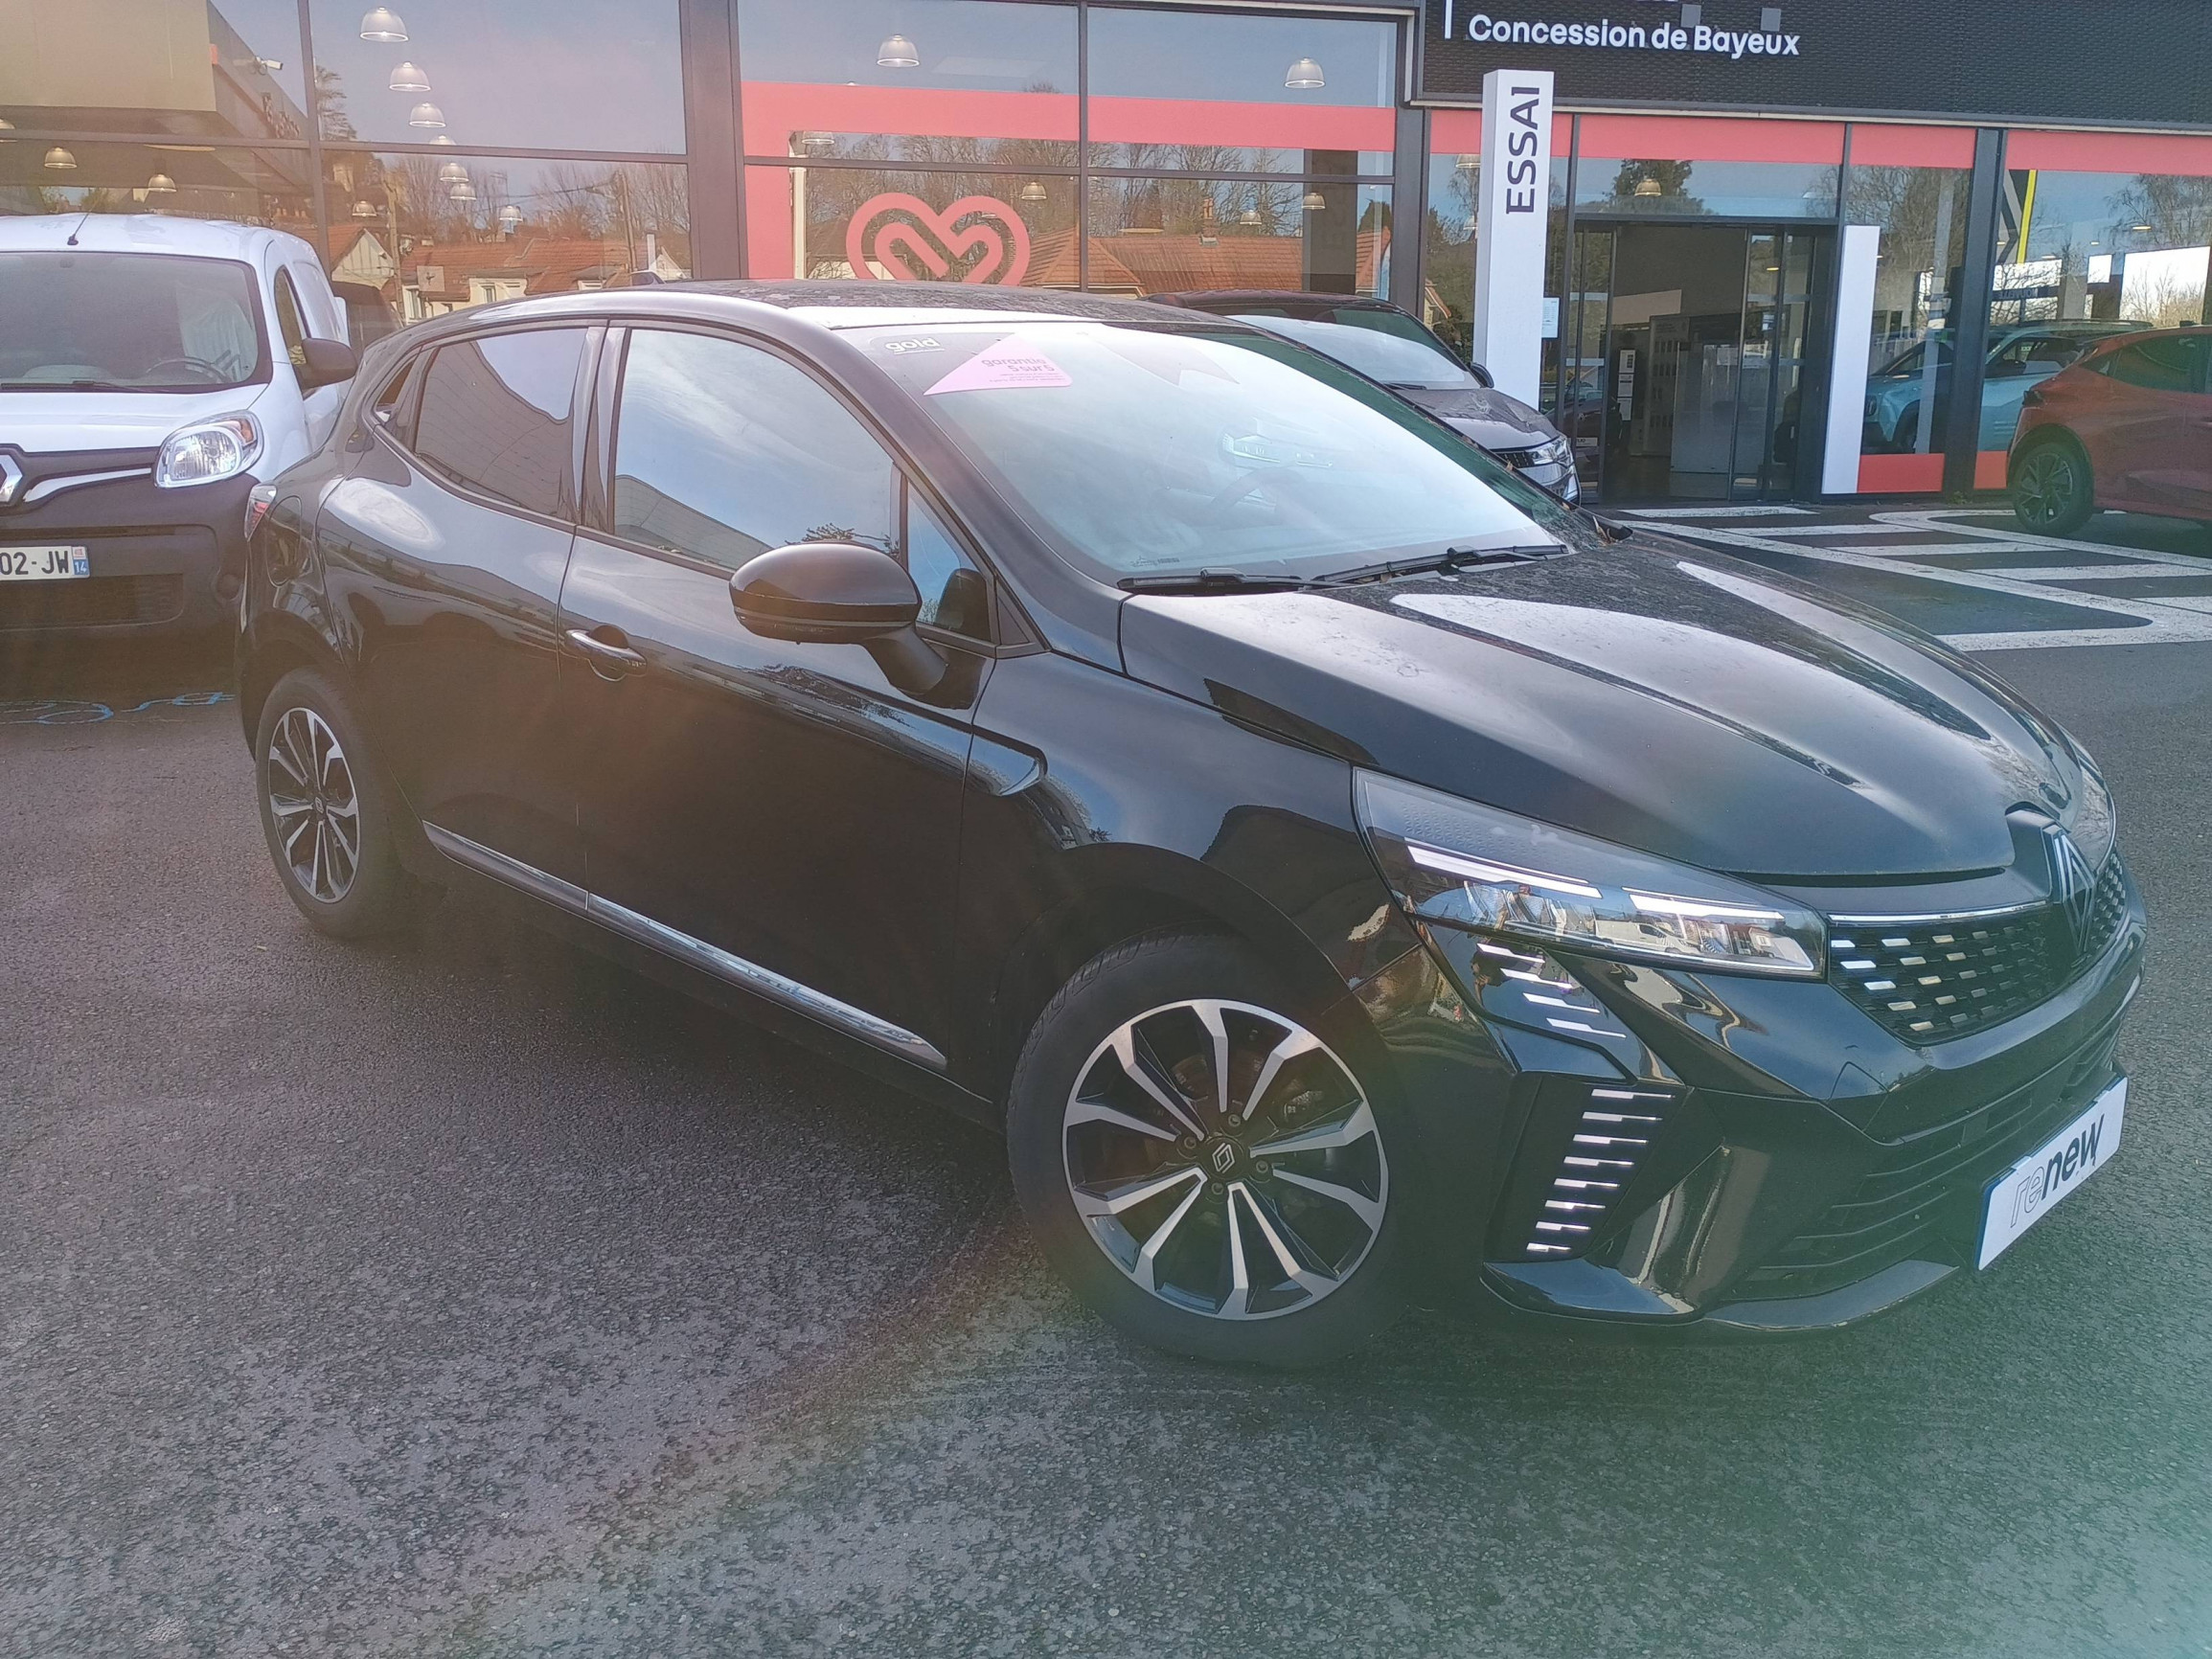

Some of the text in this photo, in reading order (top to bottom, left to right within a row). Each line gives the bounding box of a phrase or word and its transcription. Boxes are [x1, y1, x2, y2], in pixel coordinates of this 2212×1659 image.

[1469, 13, 1801, 59] Concession de Bayeux
[1506, 86, 1539, 214] ESSAI
[884, 337, 942, 353] gold
[74, 560, 88, 574] 14
[2010, 1113, 2106, 1229] renew
